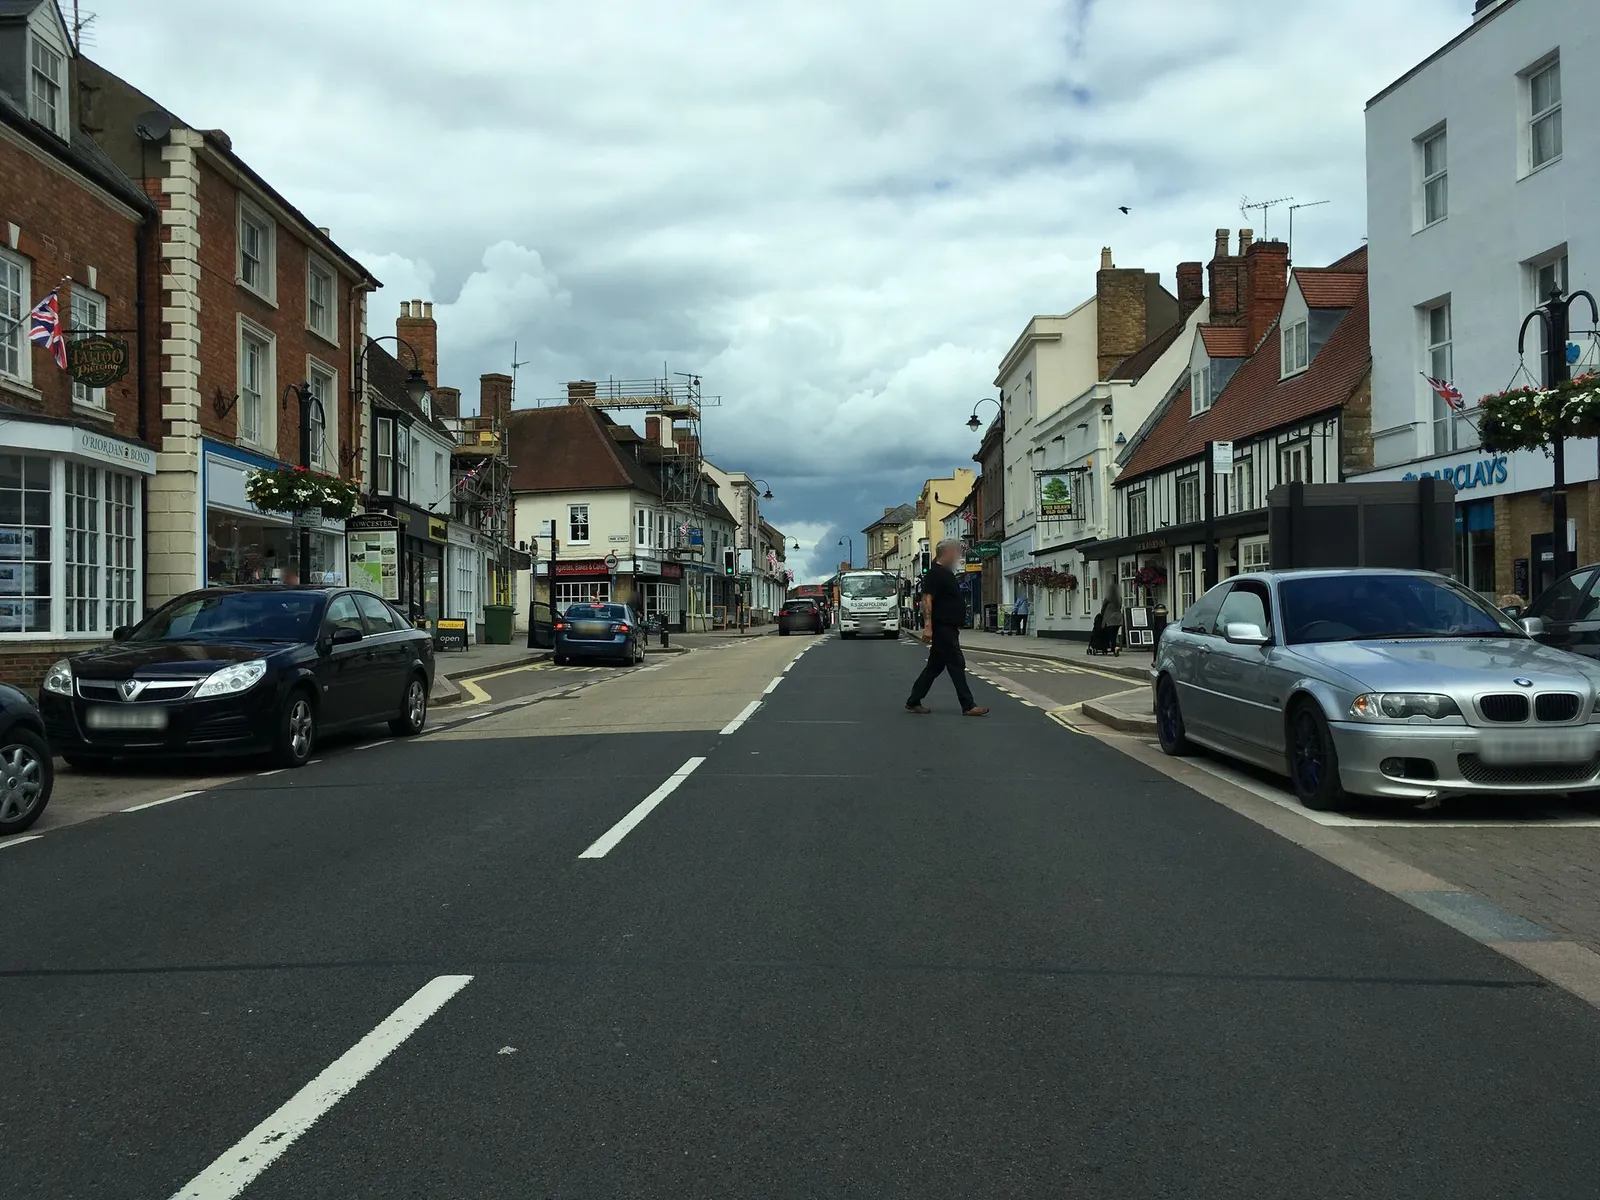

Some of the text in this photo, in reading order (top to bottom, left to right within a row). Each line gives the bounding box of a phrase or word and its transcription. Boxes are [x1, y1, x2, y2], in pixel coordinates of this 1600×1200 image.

[73, 349, 124, 365] TATTOO
[78, 363, 118, 378] Piercing
[82, 434, 150, 463] O'RIORDAN BOND
[440, 636, 460, 644] open
